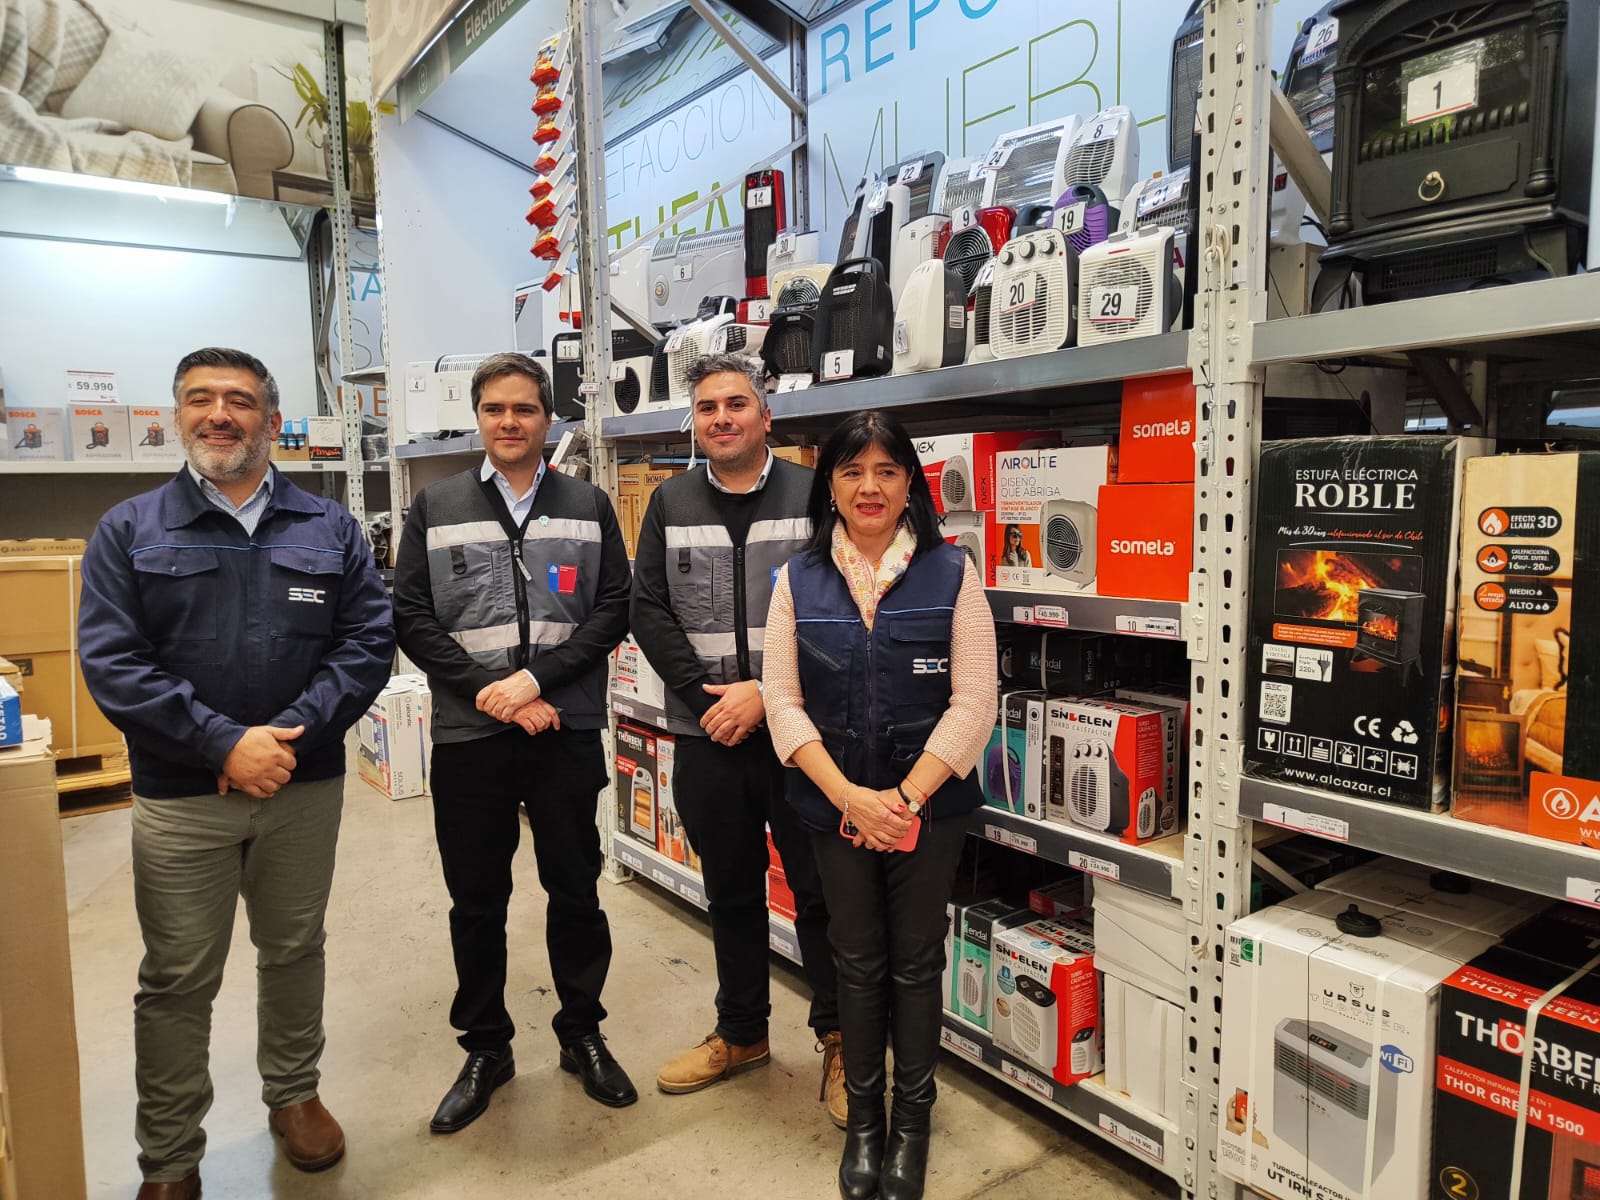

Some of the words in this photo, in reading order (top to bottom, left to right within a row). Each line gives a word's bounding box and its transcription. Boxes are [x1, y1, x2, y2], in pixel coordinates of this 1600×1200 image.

[1314, 24, 1333, 48] 26
[1432, 80, 1442, 110] 1
[1094, 124, 1103, 139] 8
[902, 166, 915, 180] 22
[753, 191, 764, 206] 14
[962, 210, 970, 227] 9
[1060, 209, 1075, 232] 19
[679, 267, 686, 279] 6
[1010, 282, 1025, 306] 20
[758, 304, 765, 318] 3
[1101, 293, 1122, 317] 29
[834, 357, 842, 375] 5
[76, 381, 114, 392] 59.990
[1132, 419, 1191, 438] somela
[1001, 455, 1057, 470] AIROLITE
[1001, 474, 1037, 487] DISEÑO
[1295, 469, 1340, 481] ESTUFA
[1344, 467, 1418, 481] ELÉCTRICA
[1001, 487, 1021, 498] QUE
[1023, 487, 1061, 497] ABRIGA
[1294, 483, 1416, 509] ROBLE
[1537, 515, 1558, 529] 3D
[1302, 525, 1315, 536] 30
[1110, 539, 1175, 556] somela
[288, 587, 326, 604] SEC
[1509, 588, 1535, 596] MEDIO
[1509, 602, 1534, 610] ALTO
[1024, 611, 1030, 621] 9
[1128, 621, 1137, 632] 10
[913, 658, 948, 674] SEC
[1354, 715, 1382, 739] CE
[1284, 767, 1391, 797] www.alcazar.cl
[1281, 811, 1286, 823] 1
[993, 830, 1001, 840] 19
[1079, 857, 1088, 868] 20
[1460, 975, 1518, 999] THOR
[1323, 988, 1391, 1018] URSUS
[1444, 1063, 1487, 1085] CALEFACTOR
[1444, 1073, 1487, 1100] THOR
[1547, 1112, 1584, 1136] 1500
[1110, 1122, 1118, 1136] 31
[1267, 1167, 1285, 1184] UT
[1288, 1178, 1312, 1199] IRH
[1271, 1160, 1344, 1200] TURBOCALEFACTOR
[1451, 1173, 1468, 1197] 2
